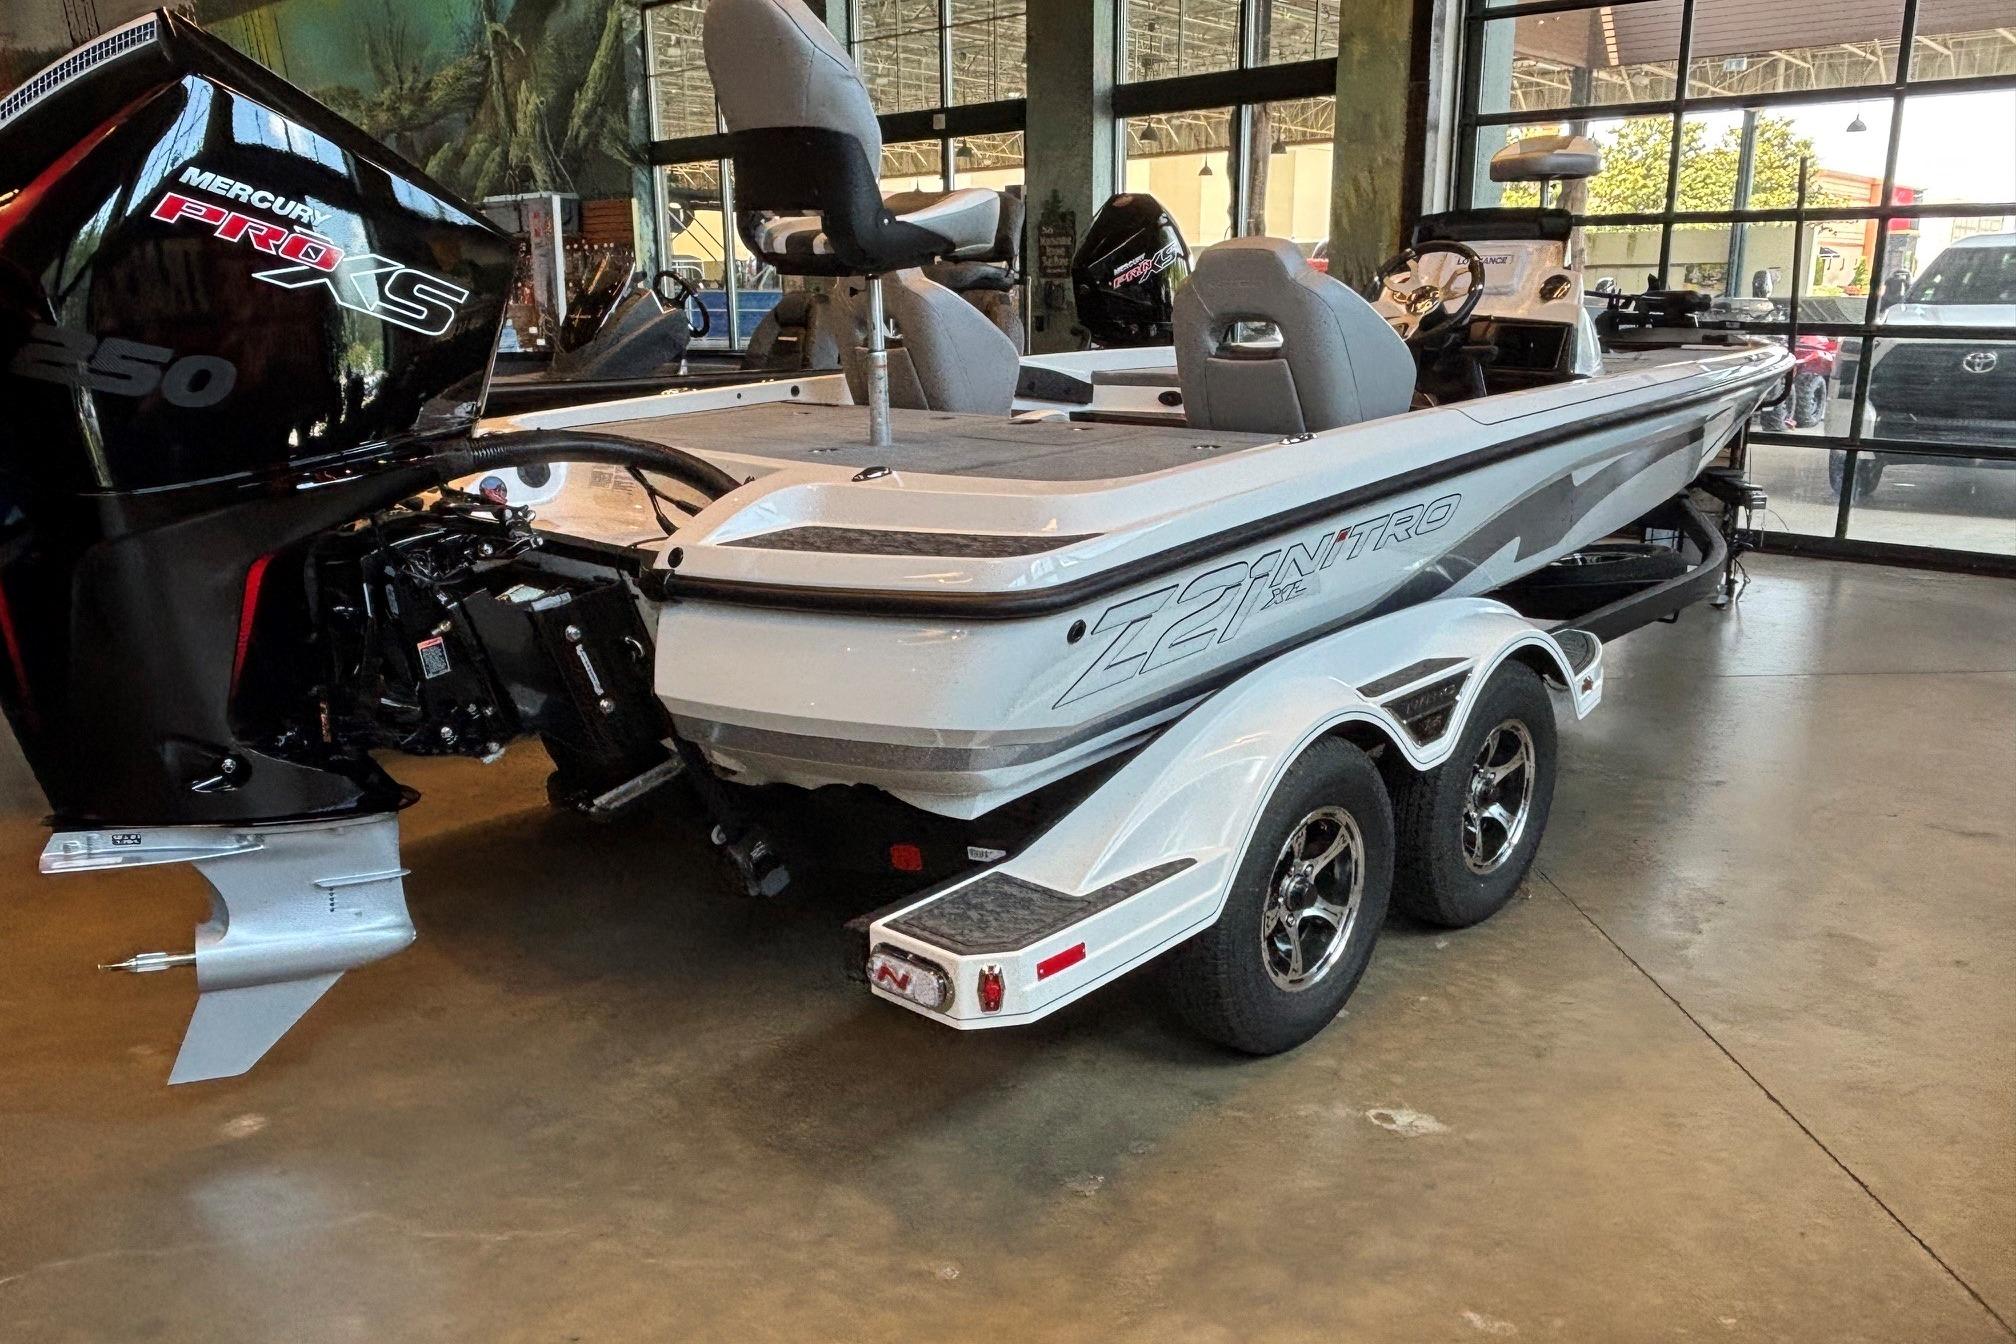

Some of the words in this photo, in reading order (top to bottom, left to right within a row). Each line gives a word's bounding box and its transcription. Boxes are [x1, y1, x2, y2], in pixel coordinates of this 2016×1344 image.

[178, 166, 333, 227] MERCURY
[151, 192, 345, 272] PRO
[252, 254, 469, 336] XS
[1457, 256, 1507, 265] LOANCE
[8, 323, 238, 408] 250
[1052, 549, 1283, 710] Z21
[1269, 493, 1462, 588] NITRO
